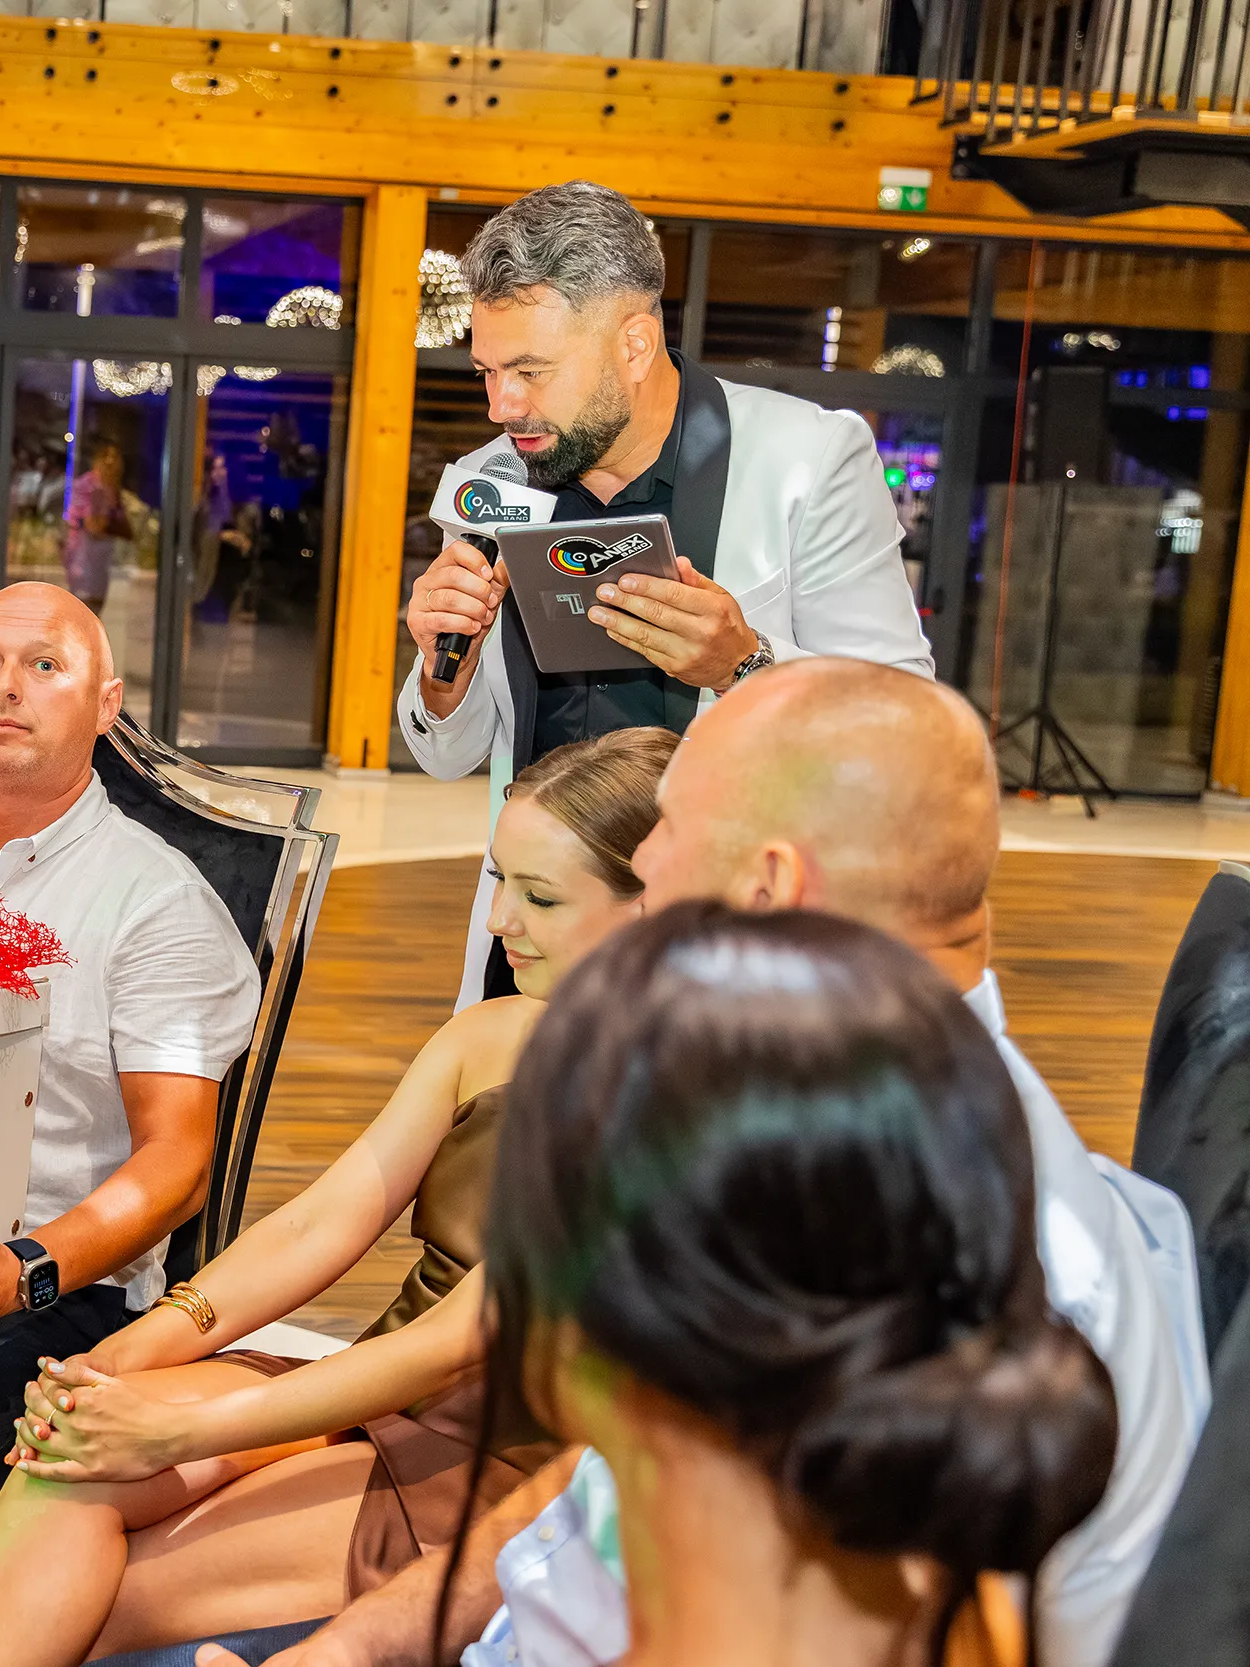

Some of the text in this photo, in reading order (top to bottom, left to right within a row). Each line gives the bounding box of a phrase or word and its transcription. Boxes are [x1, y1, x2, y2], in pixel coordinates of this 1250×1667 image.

[477, 504, 528, 518] ANEX
[589, 536, 644, 569] ANEX
[620, 542, 648, 558] BAND
